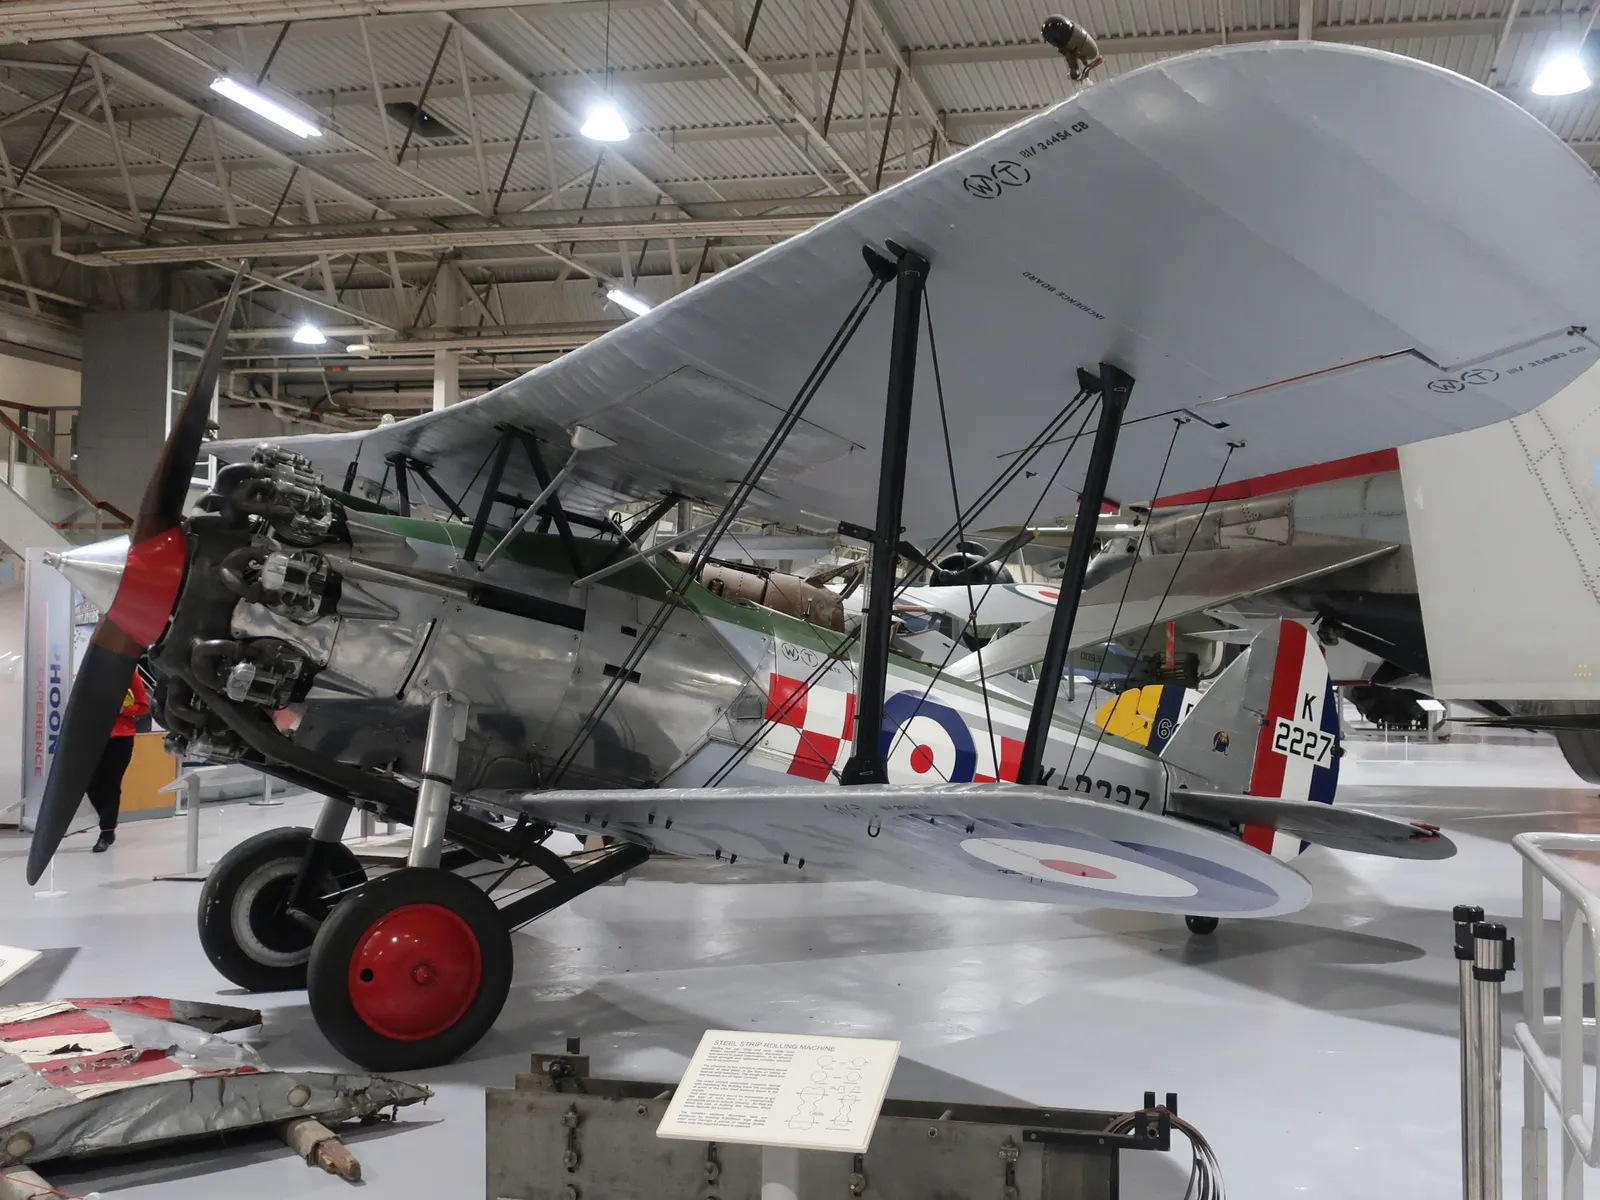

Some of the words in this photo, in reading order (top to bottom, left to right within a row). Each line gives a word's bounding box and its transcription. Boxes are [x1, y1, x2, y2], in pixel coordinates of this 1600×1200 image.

[1037, 129, 1073, 151] 34454
[1071, 121, 1089, 134] CB
[1022, 271, 1057, 293] BOARD
[1055, 291, 1106, 321] INCIDENCE
[1302, 692, 1317, 722] K
[1275, 722, 1332, 762] 2227
[713, 1039, 738, 1047] STEEL
[763, 1042, 799, 1050] ROLLING
[799, 1044, 837, 1052] MACHINE
